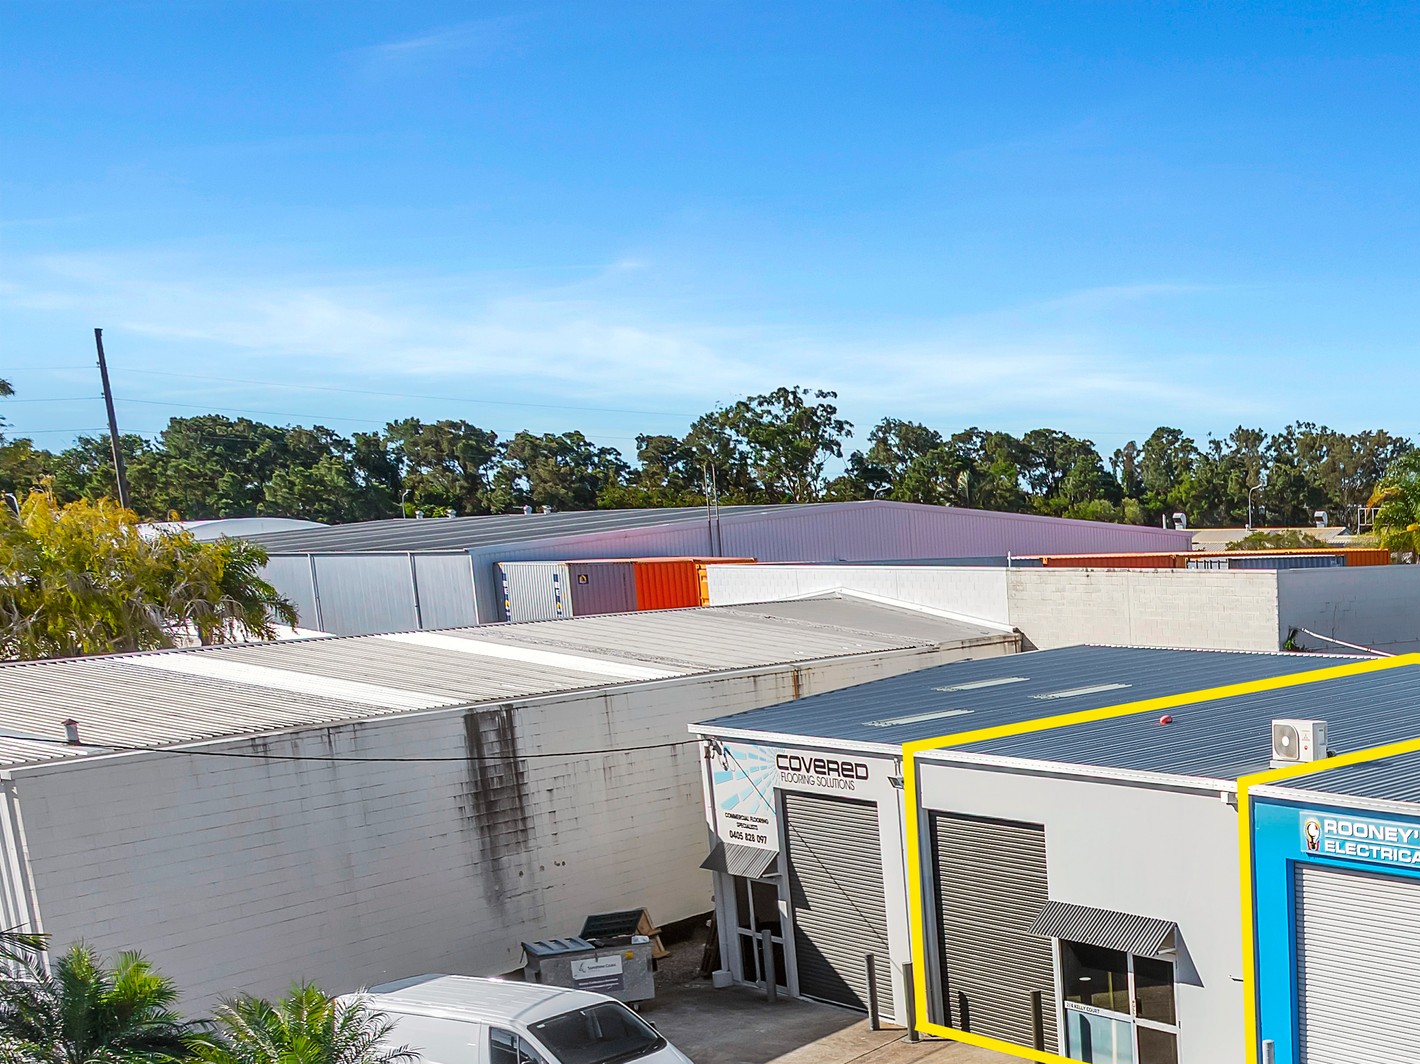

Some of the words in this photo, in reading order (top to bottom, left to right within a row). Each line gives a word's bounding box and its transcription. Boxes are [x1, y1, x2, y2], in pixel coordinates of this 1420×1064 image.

[780, 772, 816, 786] FLOORING
[816, 777, 856, 791] SOLUTIONS
[725, 812, 750, 822] COMMERCIAL
[750, 816, 769, 825] FLOORING
[729, 829, 744, 841] 0405
[744, 832, 756, 843] 828
[756, 834, 767, 845] 097
